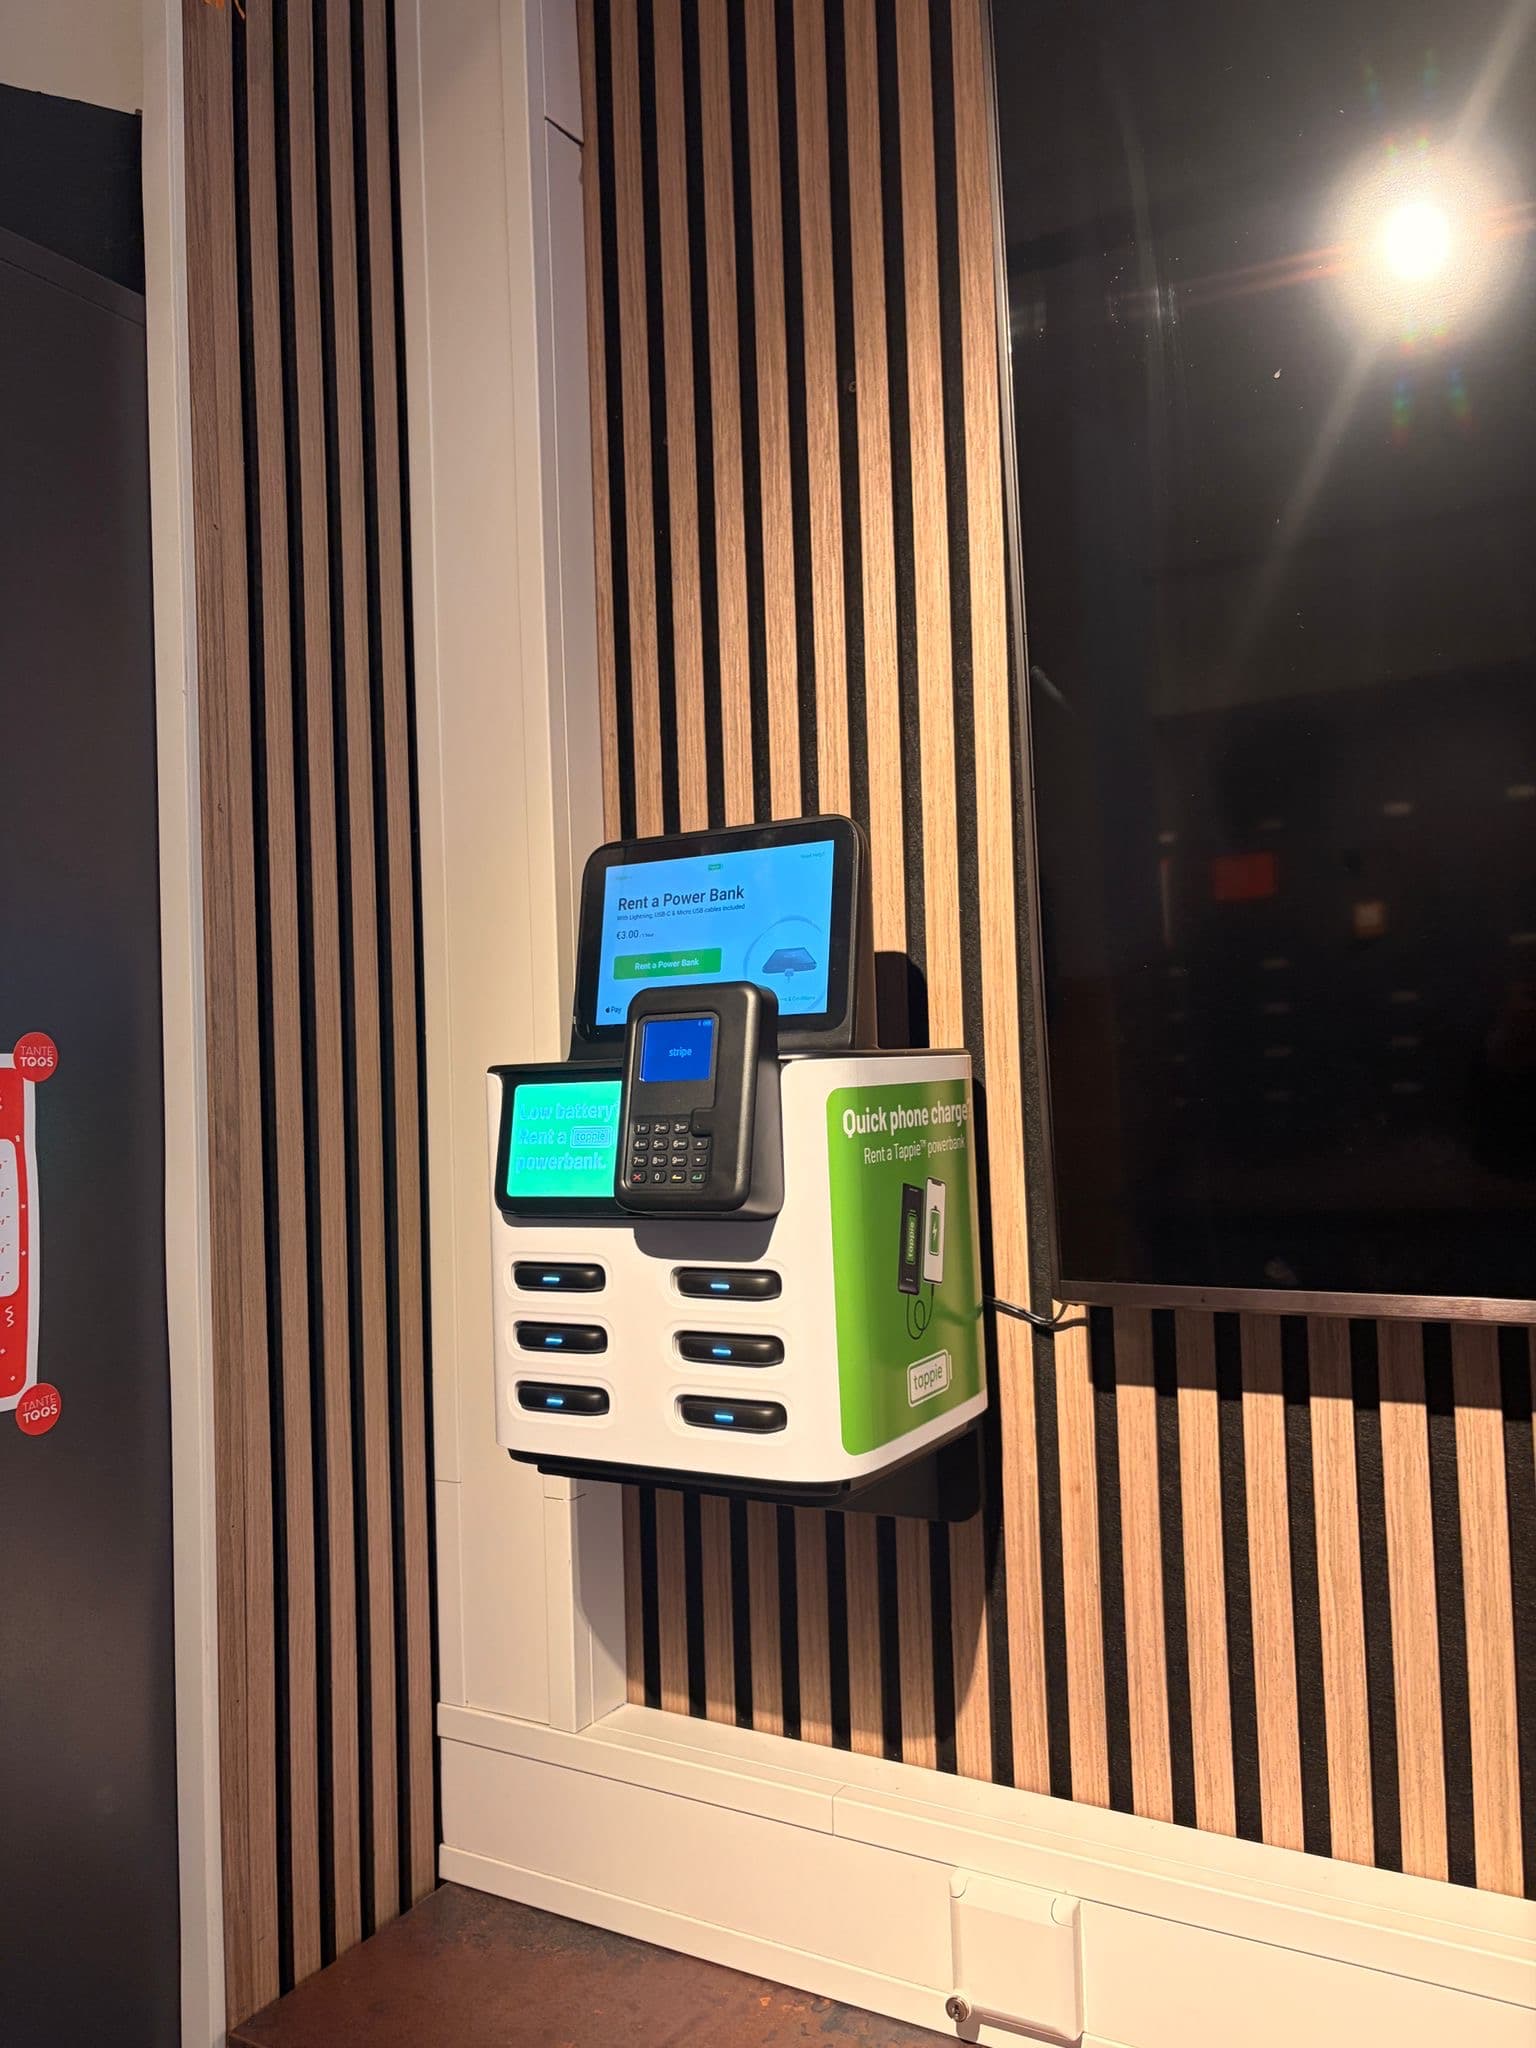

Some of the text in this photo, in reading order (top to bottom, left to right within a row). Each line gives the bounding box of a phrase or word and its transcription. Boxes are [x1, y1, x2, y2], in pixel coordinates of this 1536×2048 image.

[618, 884, 745, 911] Rent a Power Bank
[692, 907, 704, 915] USB
[704, 905, 722, 913] cables
[722, 902, 746, 911] included
[634, 961, 651, 971] Rent
[657, 959, 680, 969] Power
[681, 957, 700, 967] Bank
[610, 1006, 622, 1014] Pay
[20, 1045, 54, 1057] TANTE
[668, 1046, 693, 1058] stripe
[519, 1103, 552, 1121] Low
[842, 1106, 888, 1138] Quick
[889, 1104, 929, 1136] phone
[518, 1127, 606, 1145] Rent a tappie
[863, 1146, 886, 1164] Rent
[886, 1148, 893, 1161] a
[927, 1134, 966, 1158] powerbank
[515, 1151, 607, 1174] powerbank.
[913, 1363, 943, 1391] tappie
[23, 1393, 57, 1412] TANTE
